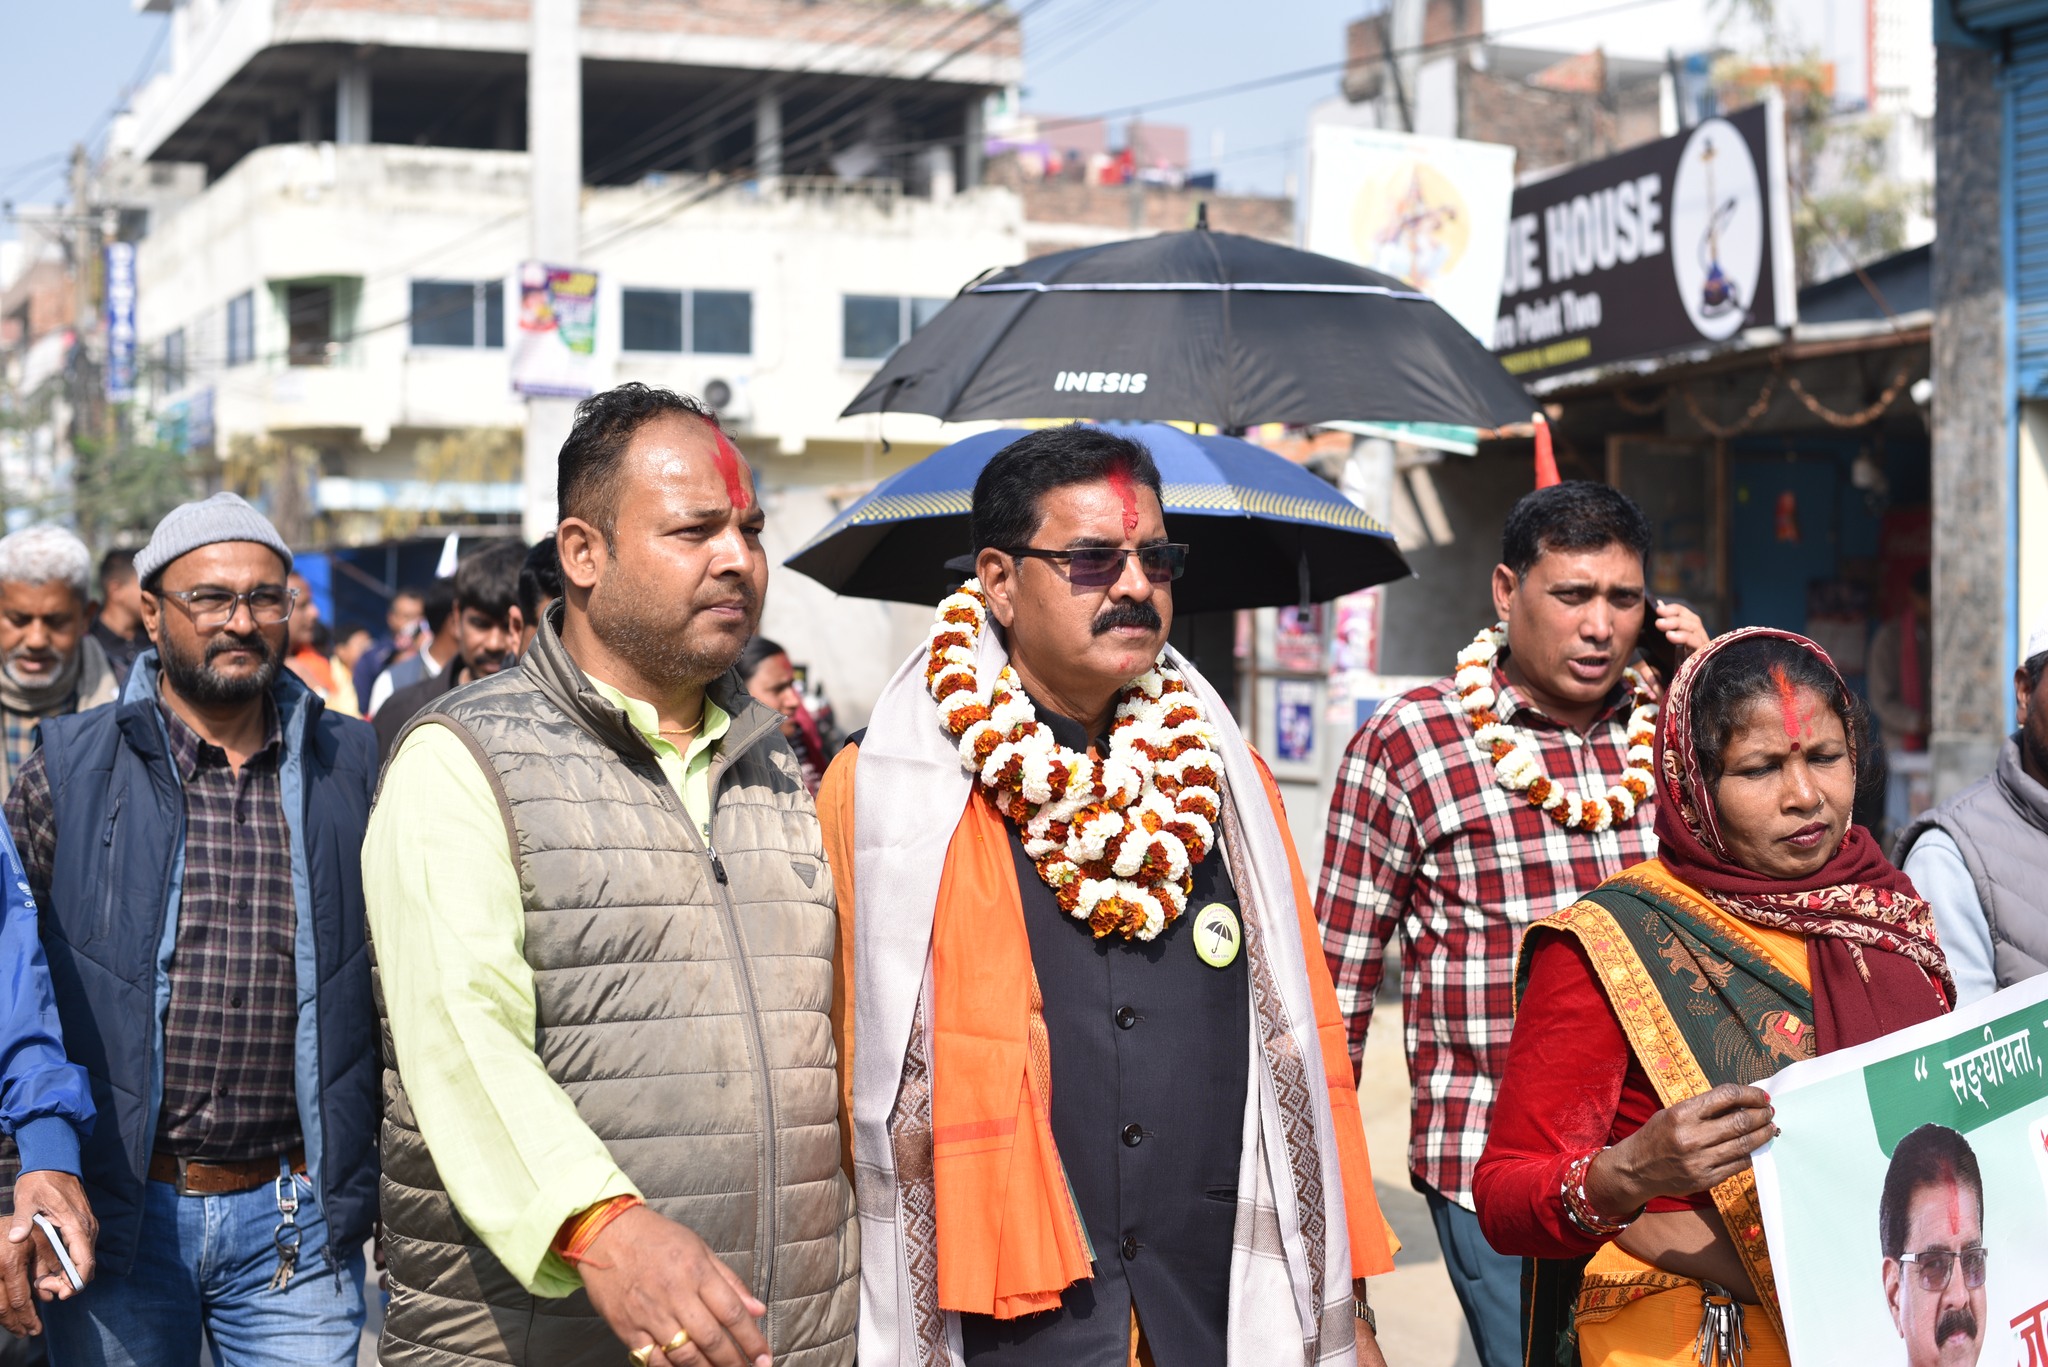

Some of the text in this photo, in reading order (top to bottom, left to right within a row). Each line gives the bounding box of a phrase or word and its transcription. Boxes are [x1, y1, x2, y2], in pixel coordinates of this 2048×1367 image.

[1545, 173, 1664, 283] HOUSE
[1516, 295, 1562, 345] Point
[1561, 290, 1601, 332] Two
[1054, 371, 1148, 394] INESIS
